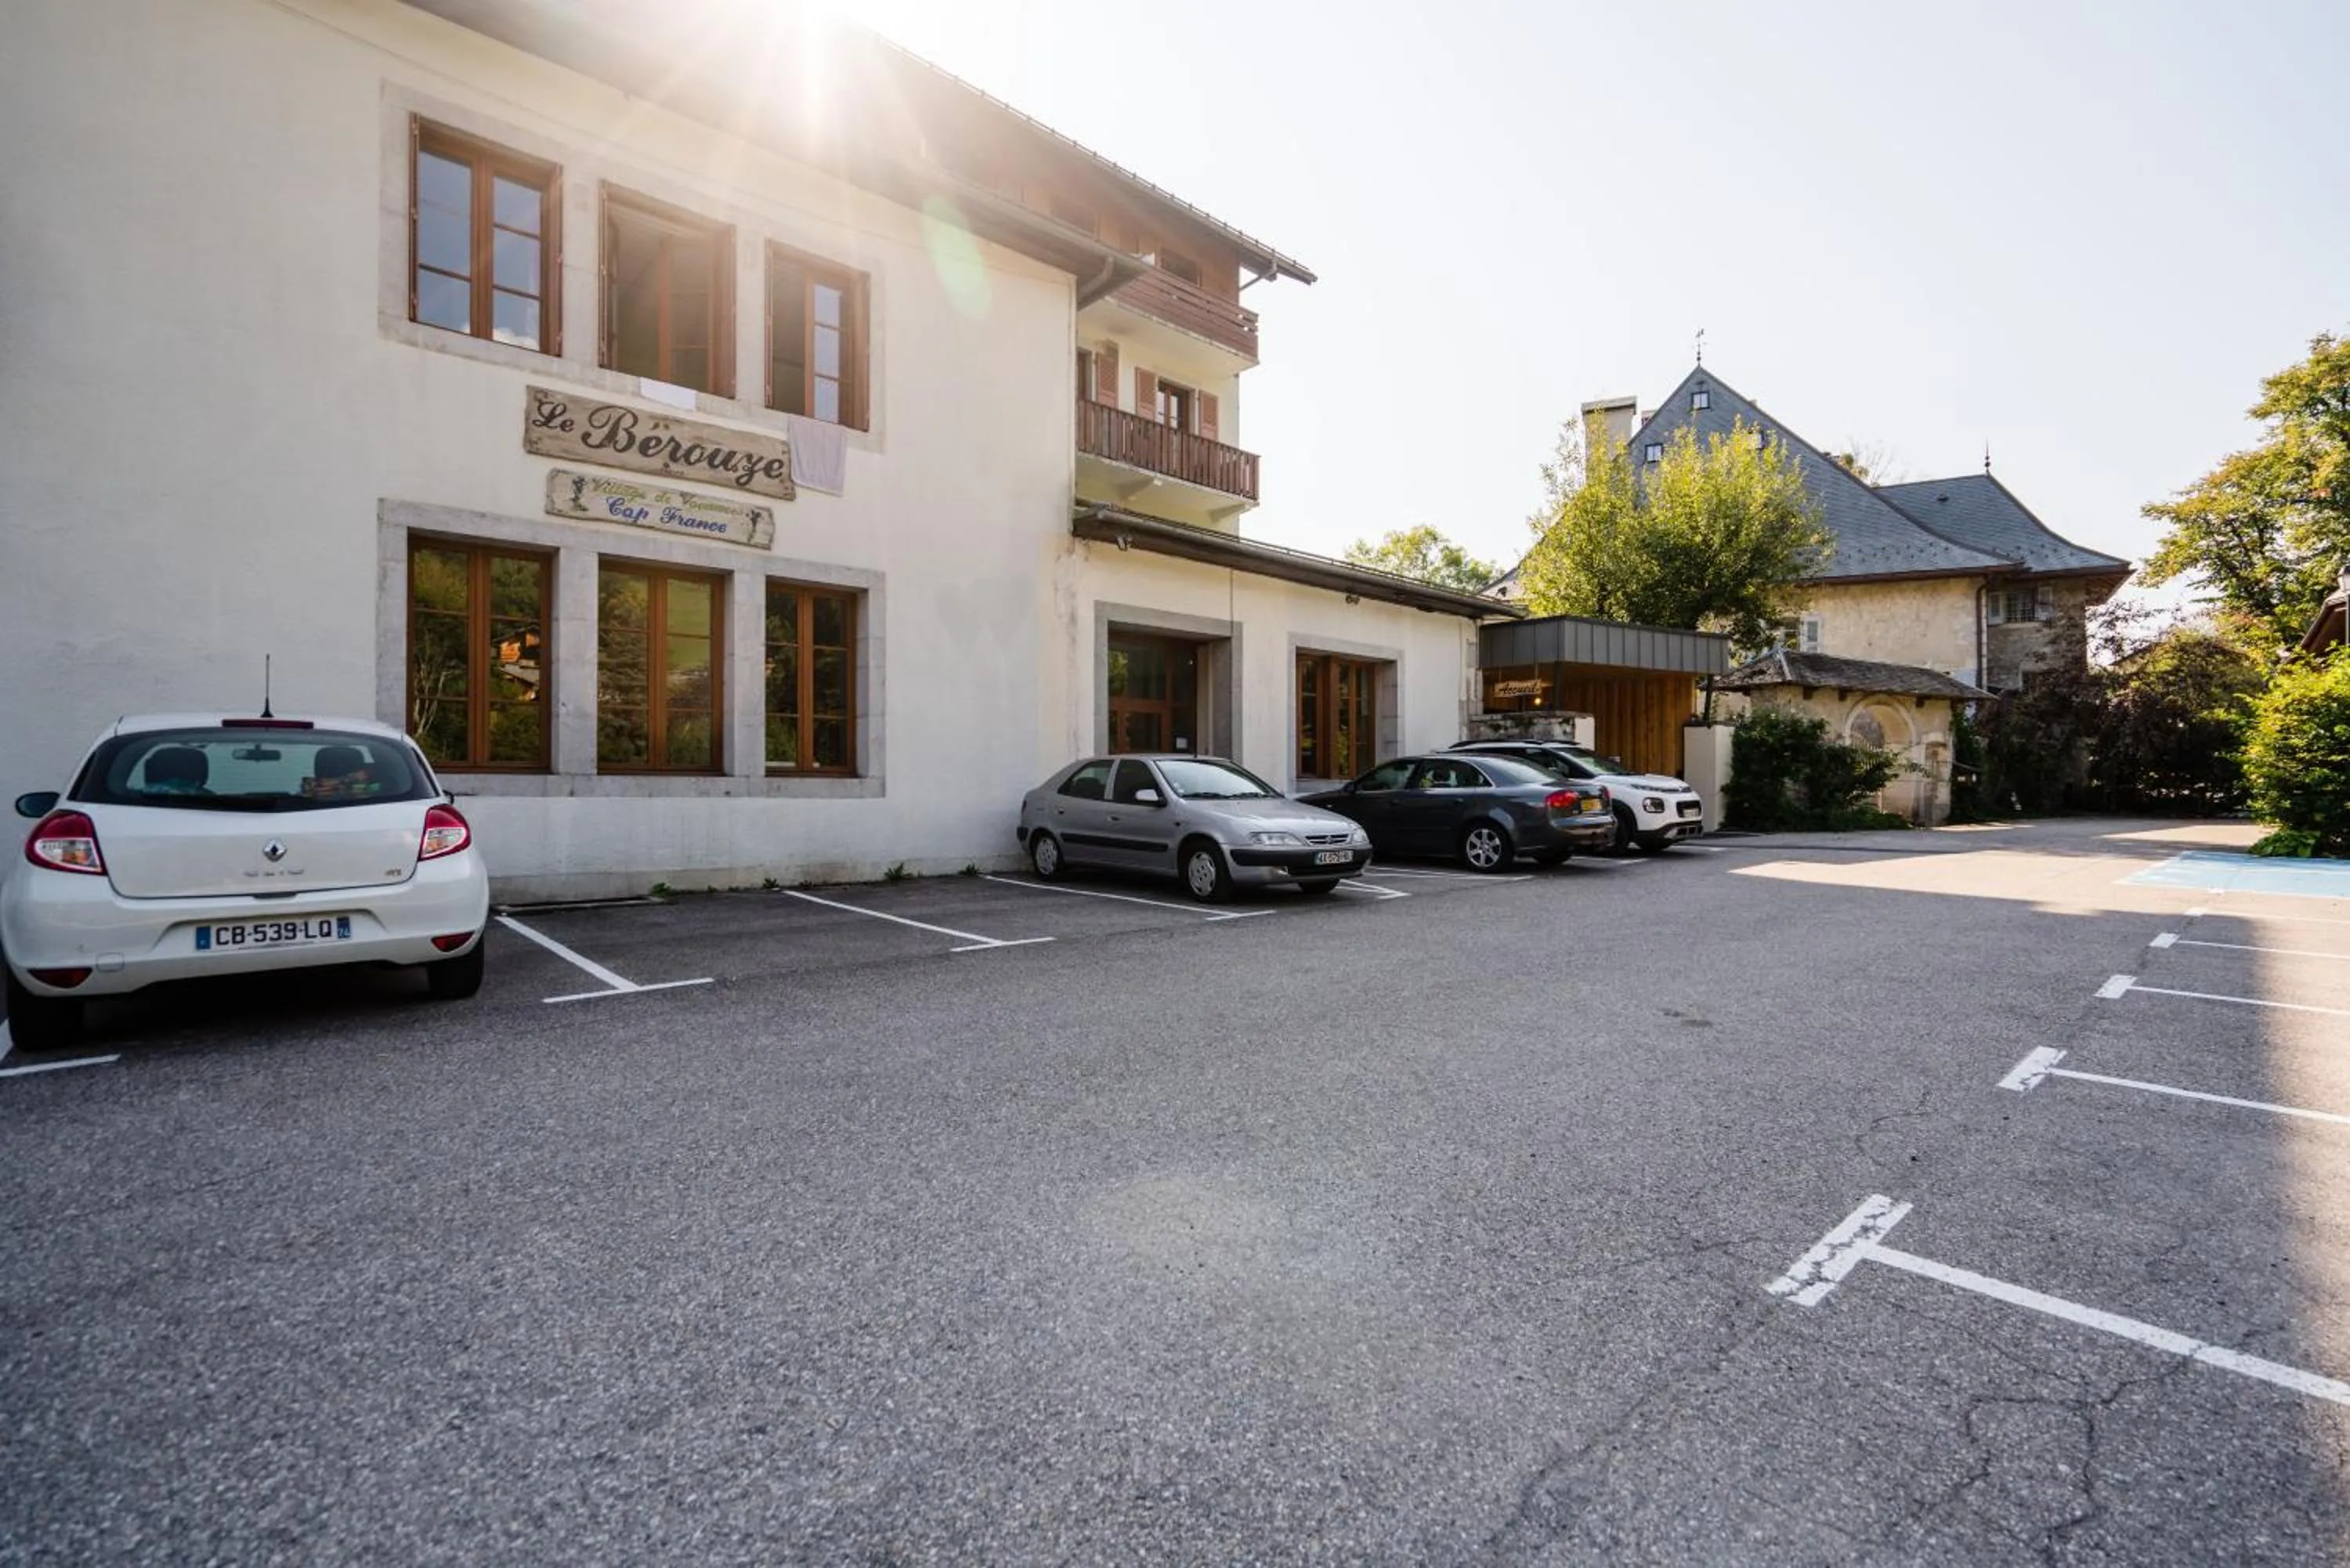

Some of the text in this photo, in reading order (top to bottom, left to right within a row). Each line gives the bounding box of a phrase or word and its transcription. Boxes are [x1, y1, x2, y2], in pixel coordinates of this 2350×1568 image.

[532, 402, 574, 432] Le
[606, 497, 728, 533] Cap France
[215, 919, 331, 945] CB-539-LQ
